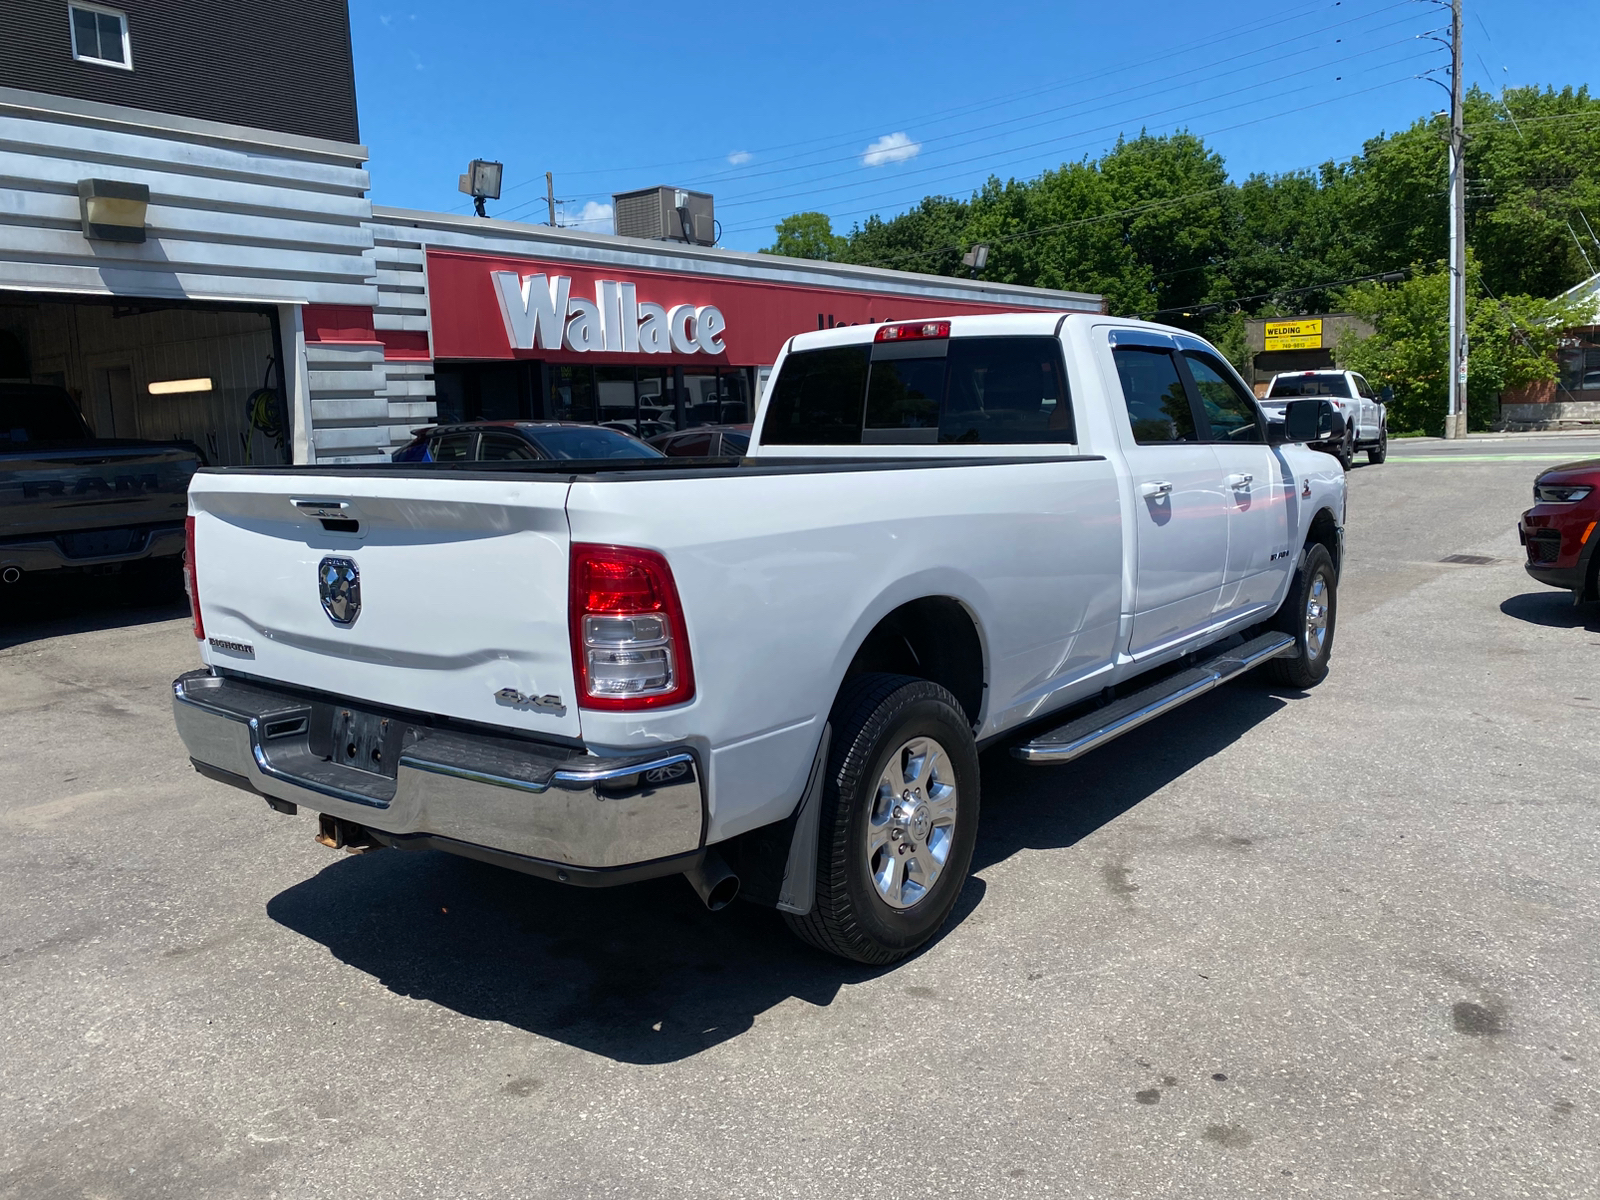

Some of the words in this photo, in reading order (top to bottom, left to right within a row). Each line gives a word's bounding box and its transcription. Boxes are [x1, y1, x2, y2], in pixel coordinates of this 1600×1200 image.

[490, 270, 726, 355] Wallace
[1267, 326, 1301, 335] WELDING
[23, 473, 159, 498] RAM
